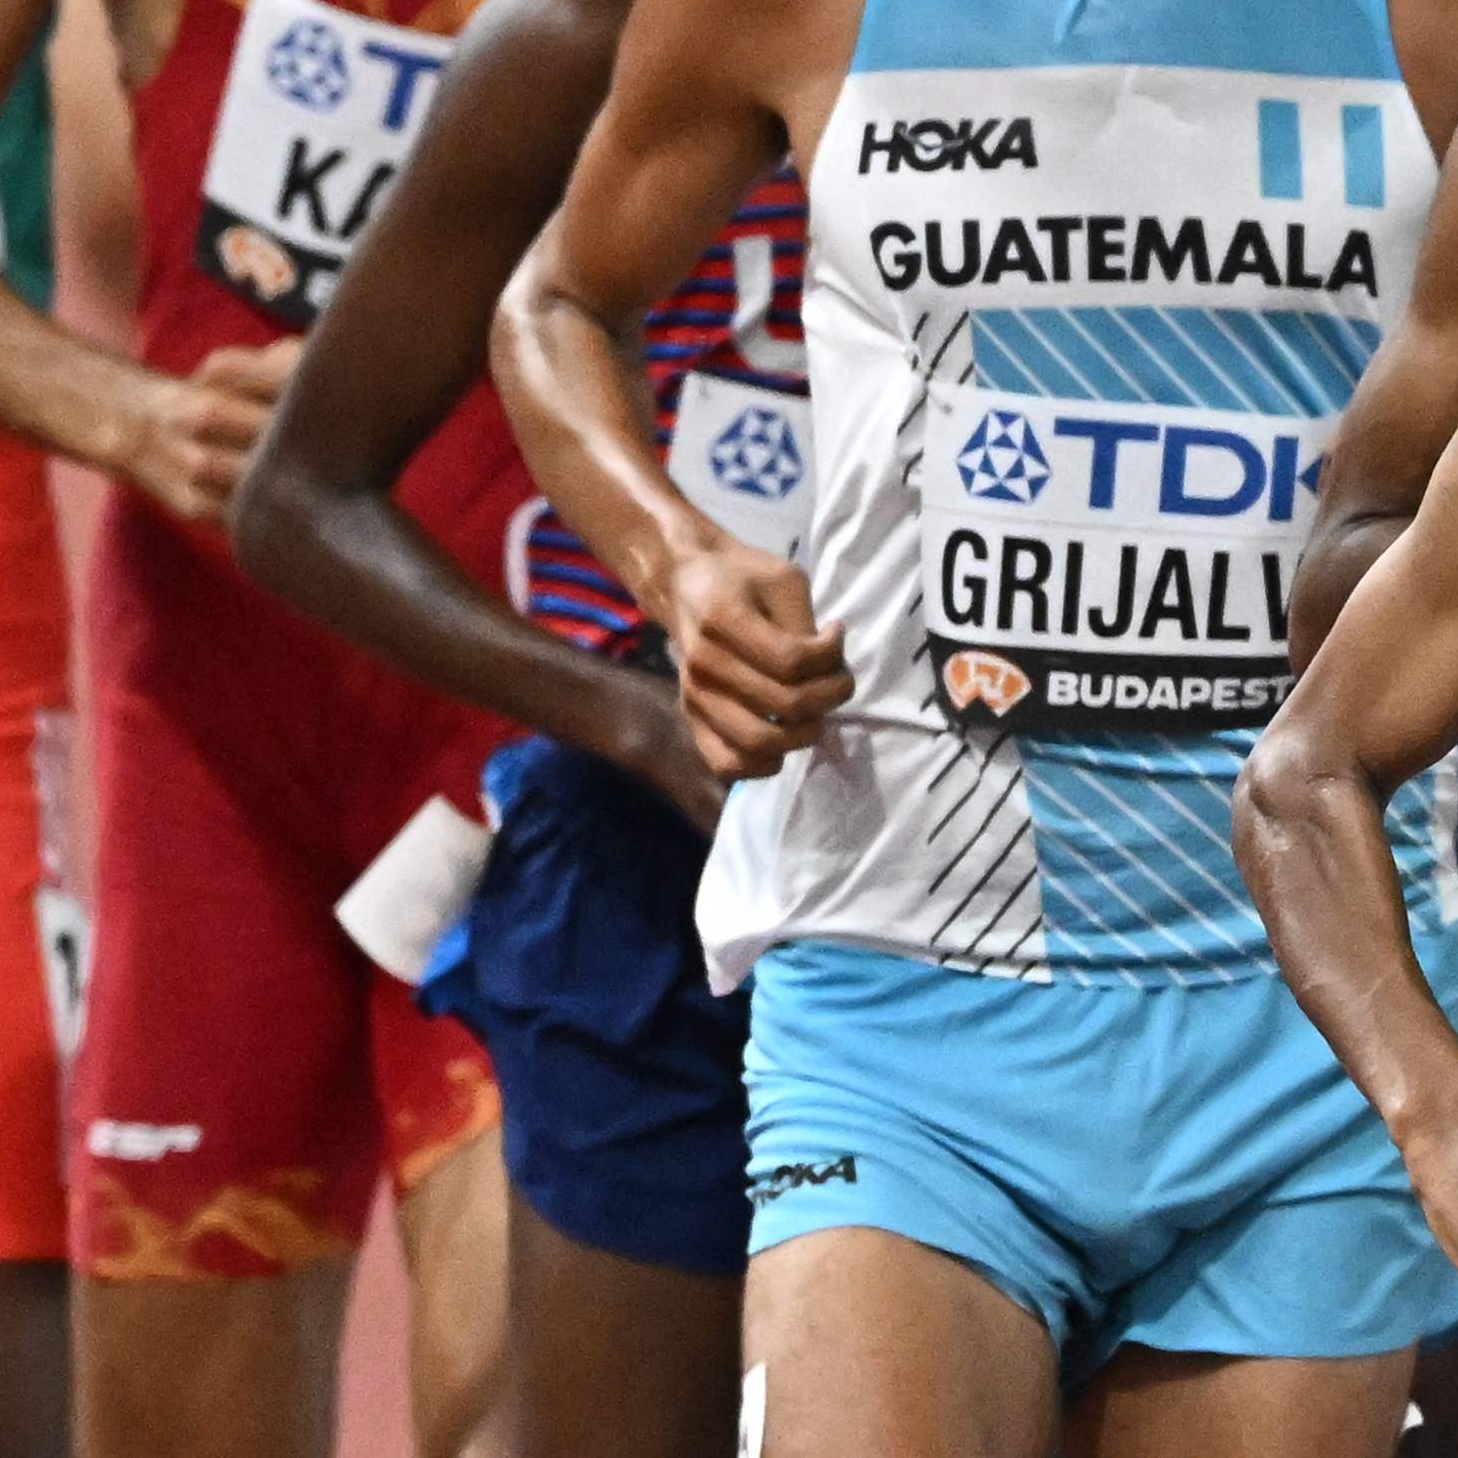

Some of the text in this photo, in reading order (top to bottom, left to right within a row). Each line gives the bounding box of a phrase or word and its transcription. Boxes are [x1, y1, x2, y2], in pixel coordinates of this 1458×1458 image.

[857, 117, 1040, 175] HOKA
[870, 216, 1380, 299] GUATEMALA
[941, 528, 1305, 642] GRIJALV
